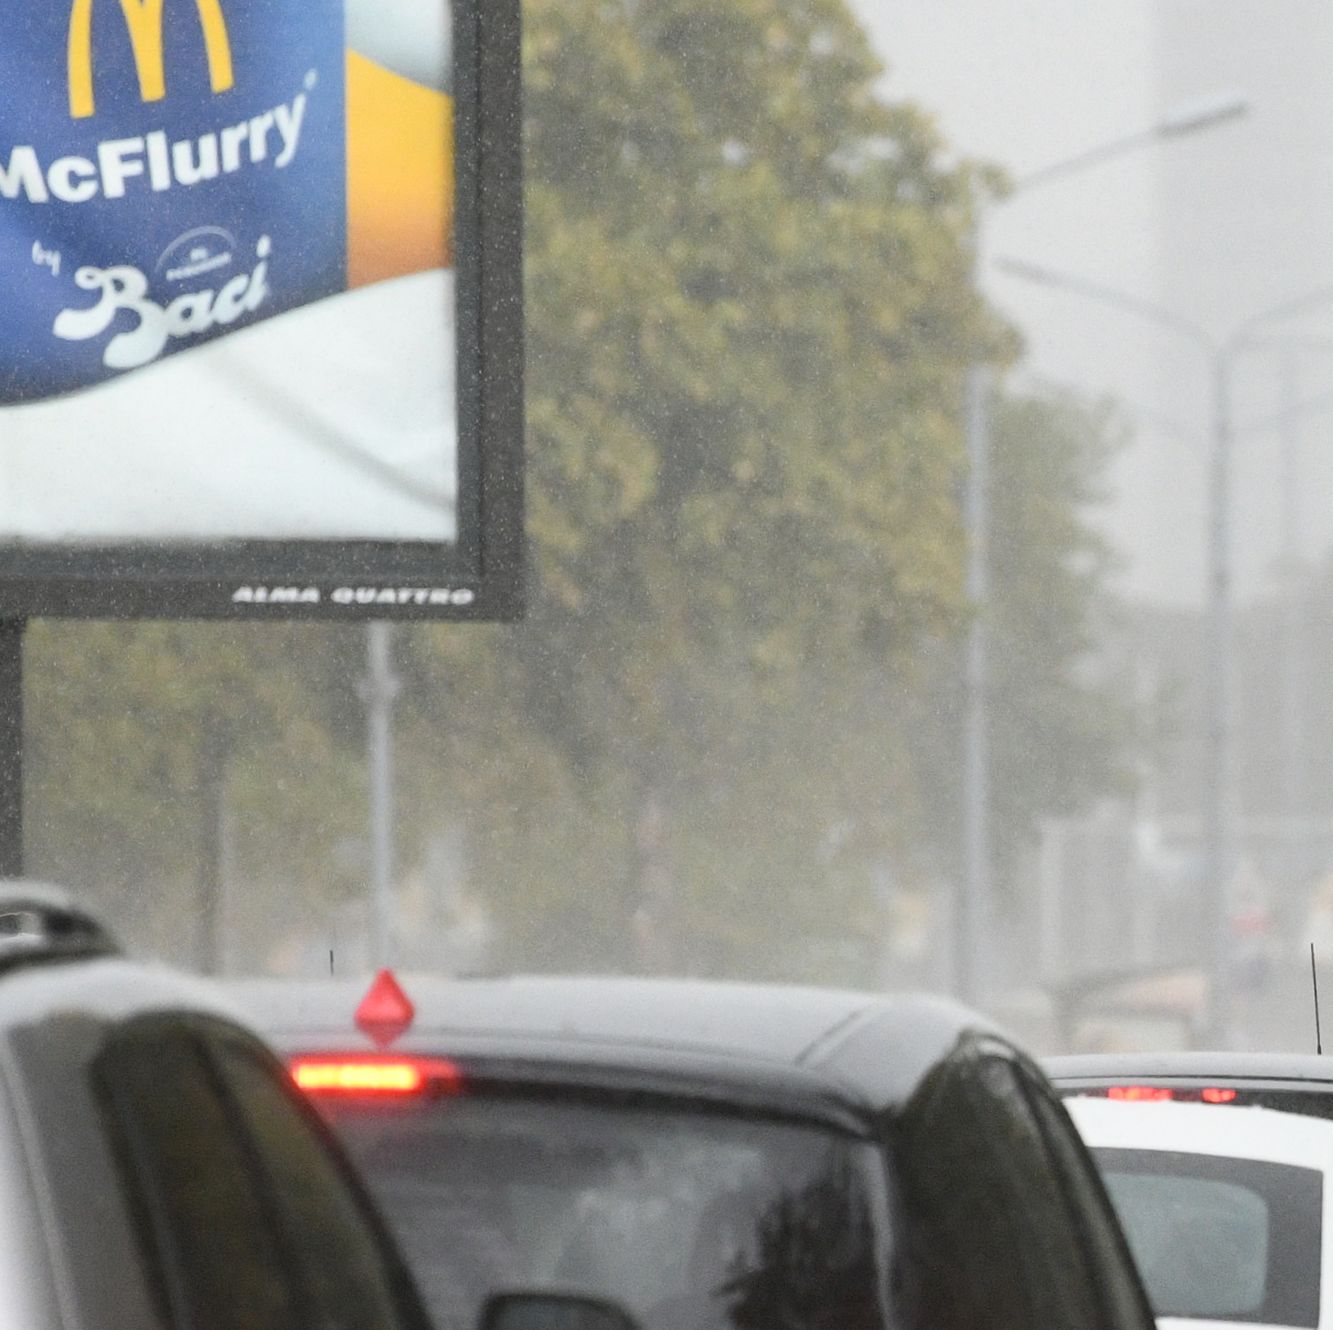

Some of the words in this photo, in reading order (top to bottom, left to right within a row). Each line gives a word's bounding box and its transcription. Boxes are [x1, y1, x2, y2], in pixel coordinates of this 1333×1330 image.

[0, 93, 306, 203] McFlurry
[53, 235, 271, 369] Baci
[232, 586, 320, 604] ALMA
[331, 587, 475, 605] QUATTRO
